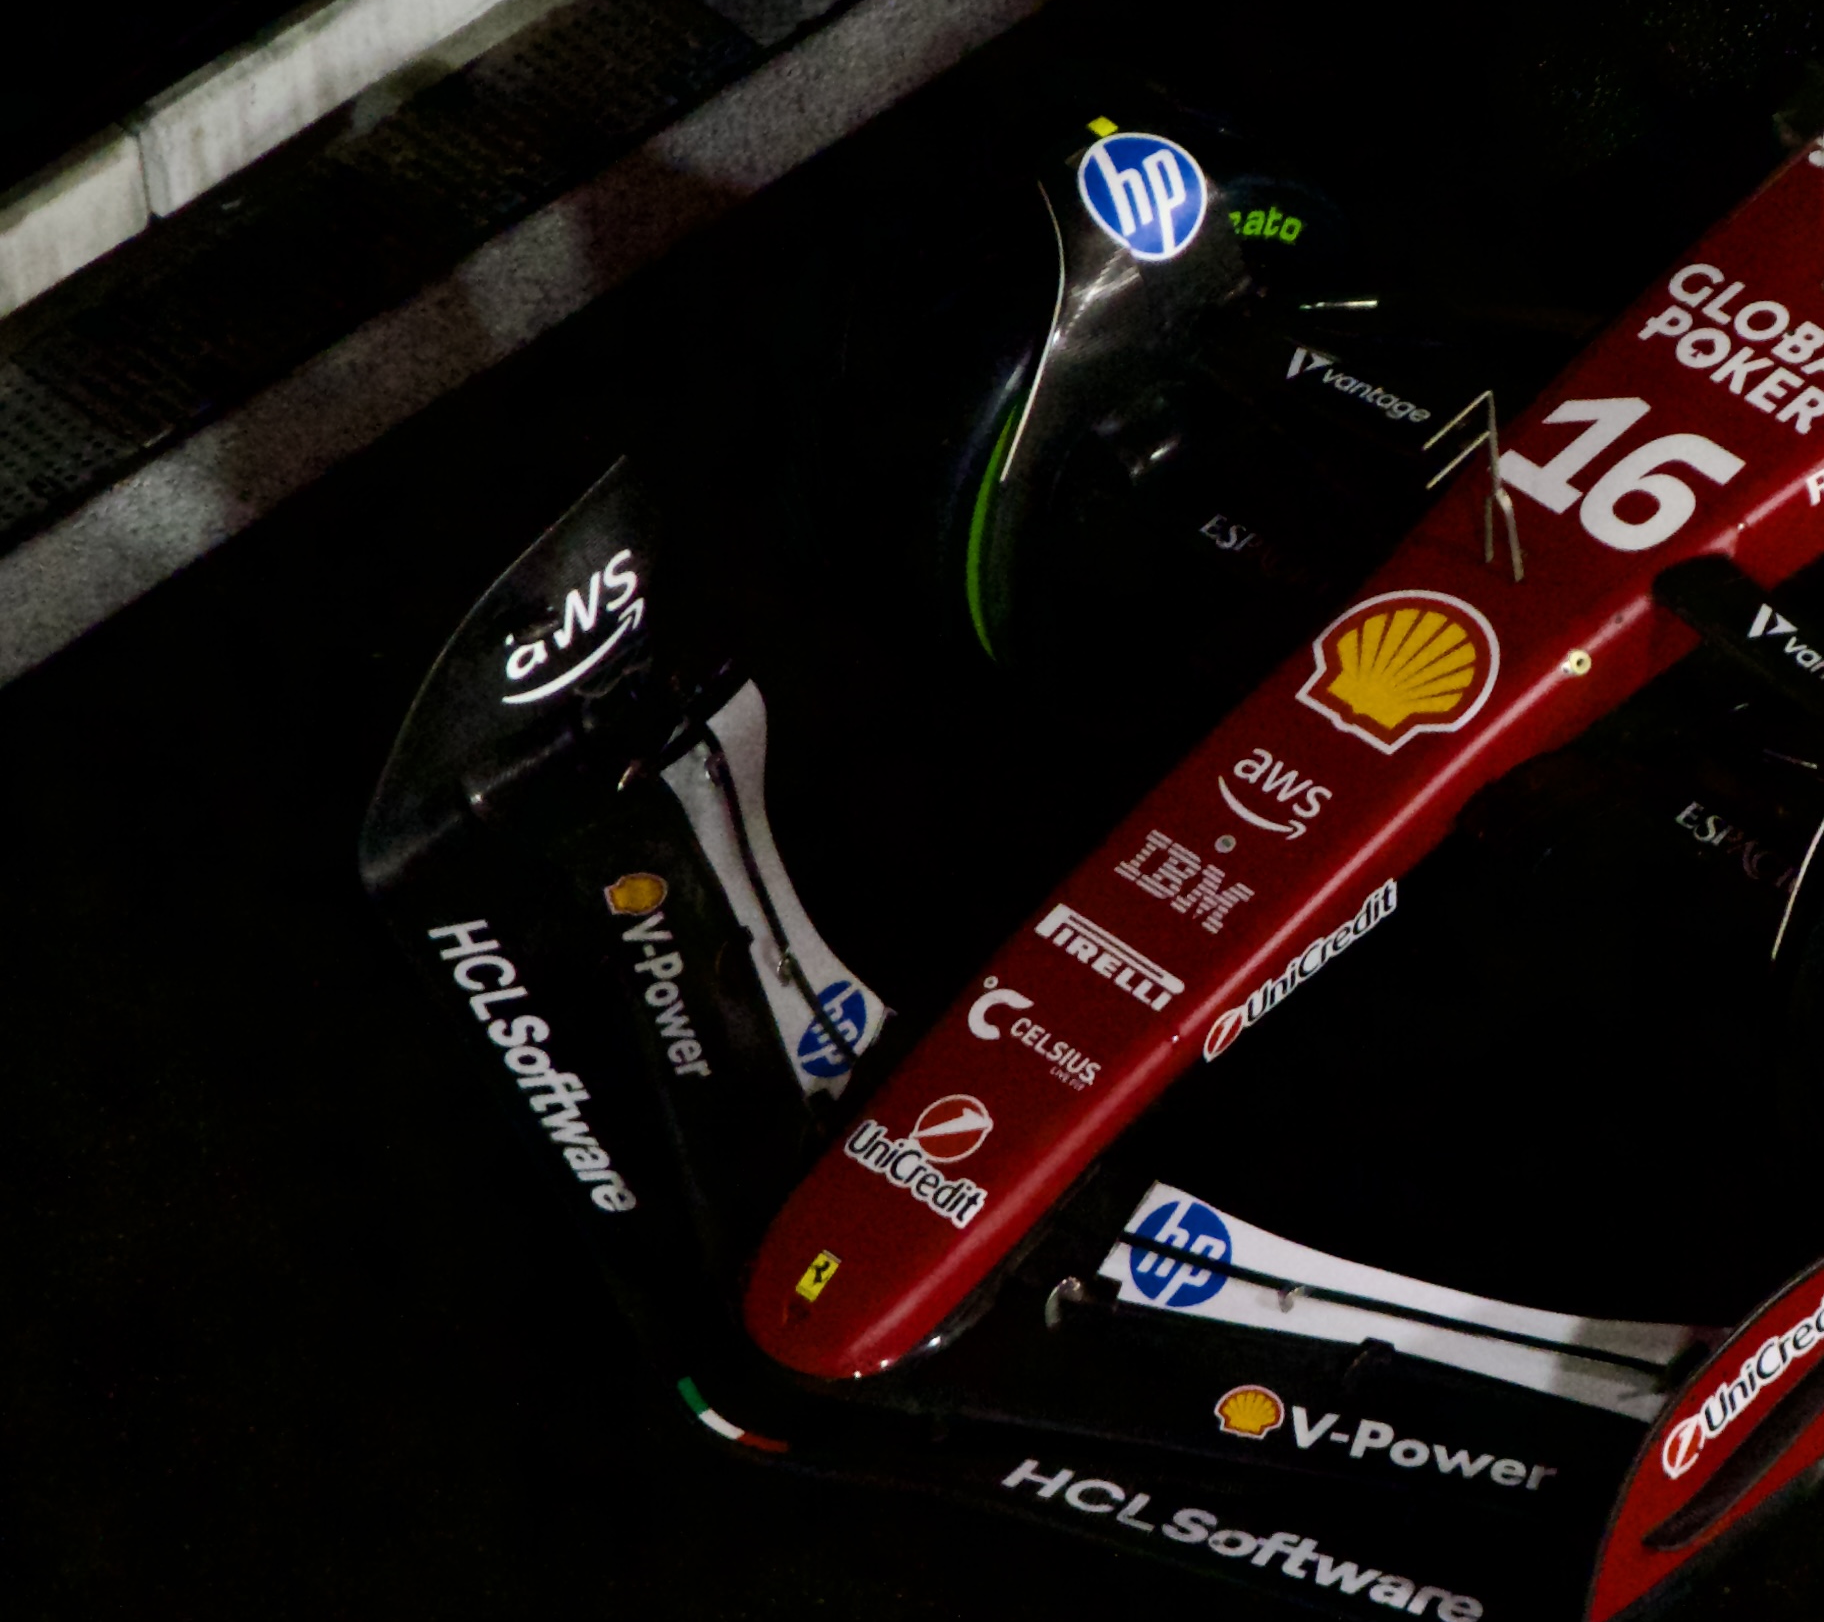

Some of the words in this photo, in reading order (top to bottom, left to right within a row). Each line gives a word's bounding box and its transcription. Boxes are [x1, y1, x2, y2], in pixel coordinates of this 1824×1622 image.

[1086, 136, 1198, 260] hp
[1322, 366, 1432, 423] vantage
[1499, 396, 1748, 553] 16
[504, 548, 642, 682] aws
[1232, 747, 1334, 822] aws
[1113, 828, 1256, 936] IBM
[620, 911, 712, 1083] V-Power
[1034, 902, 1187, 1013] PIRELLI
[1248, 879, 1402, 1025] UniCredit
[427, 916, 641, 1217] HCLSoftware
[1009, 1015, 1103, 1087] CELSIUS
[846, 1119, 990, 1229] UniCredit
[1131, 1200, 1232, 1308] hp
[1290, 1403, 1558, 1493] V-Power
